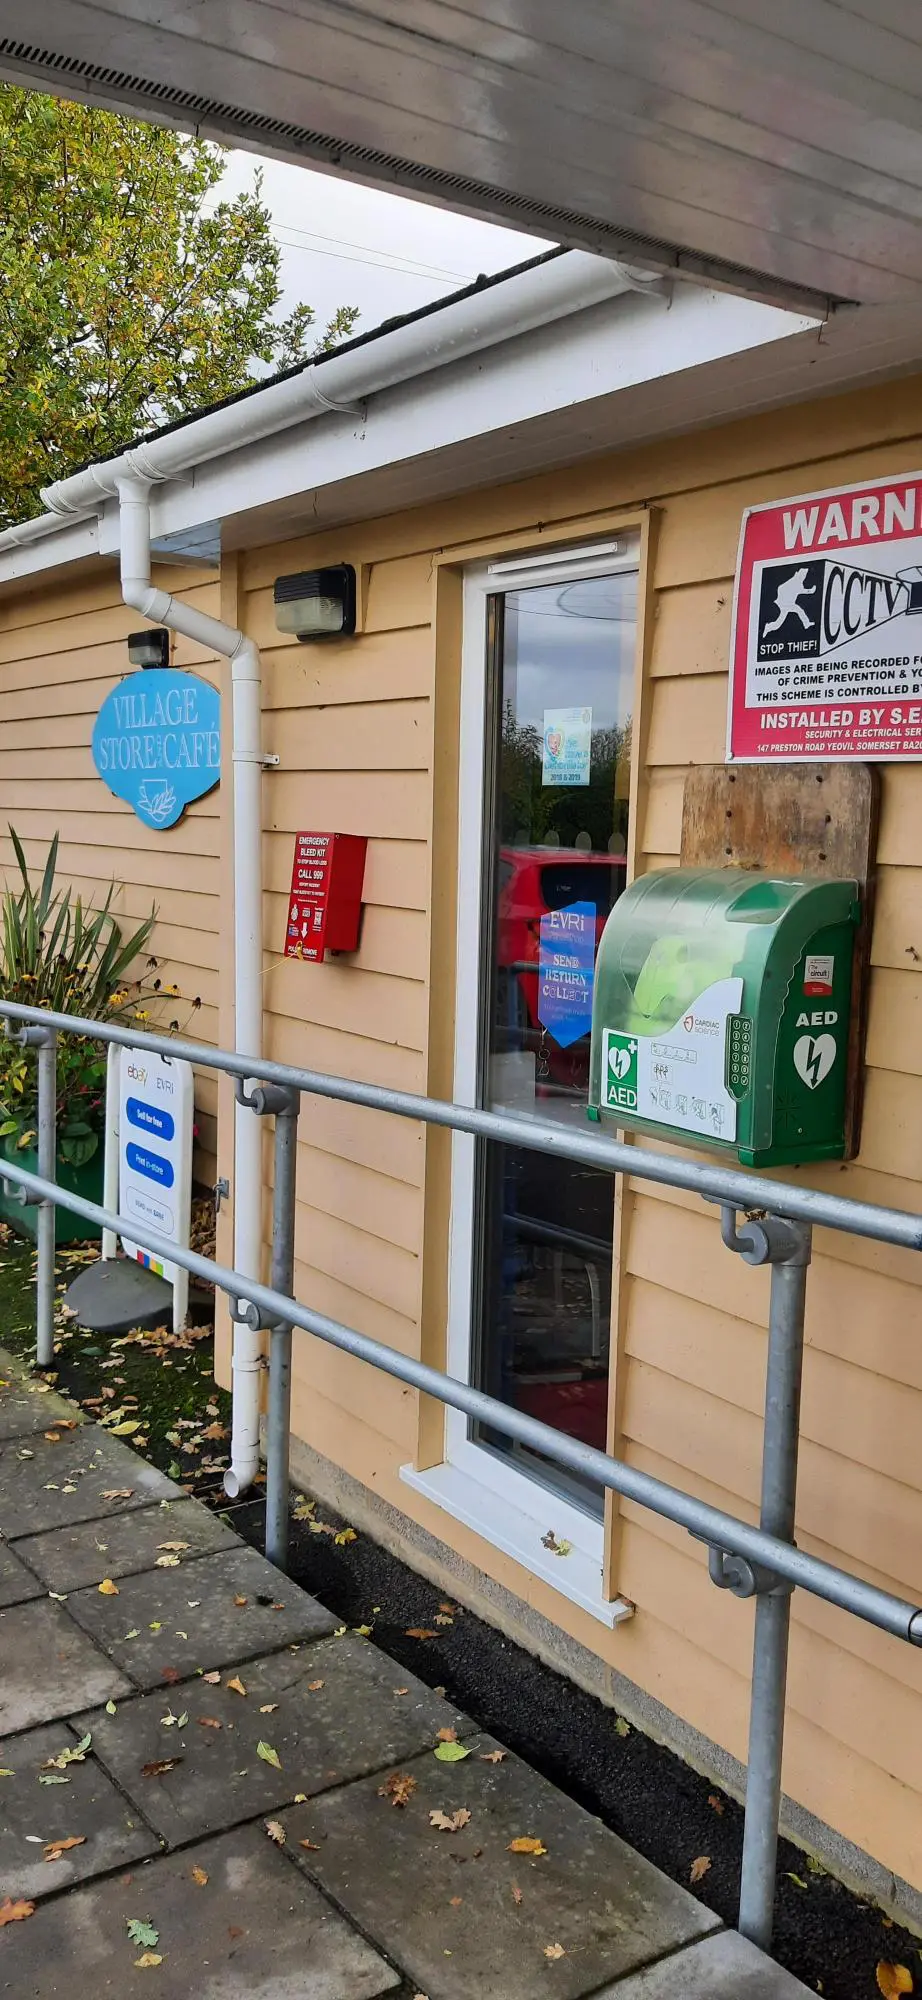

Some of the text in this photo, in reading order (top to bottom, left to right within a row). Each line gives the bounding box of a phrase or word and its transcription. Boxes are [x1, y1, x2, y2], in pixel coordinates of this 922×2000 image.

[783, 487, 922, 550] WARN
[824, 566, 902, 645] CCTV
[760, 641, 817, 655] STOP THIEF!
[755, 656, 922, 676] IMAGES ARE BEING RECORDED F
[778, 677, 790, 687] OF
[793, 675, 824, 686] CRIME
[827, 670, 895, 684] PREVENTION
[899, 670, 906, 679] &
[756, 684, 922, 702] THIS SCHEME IS CONTROLLED B
[112, 688, 199, 729] VILLAGE
[760, 710, 854, 729] INSTALLED
[859, 708, 885, 726] BY
[805, 730, 843, 739] SECURITY
[844, 729, 851, 738] &
[853, 728, 902, 738] ELECTRICAL
[100, 735, 157, 770] STORE
[163, 721, 220, 768] CAFÉ
[757, 744, 769, 752] 147
[770, 743, 803, 752] PRESTON
[805, 743, 825, 752] ROAD
[828, 742, 855, 752] YEOVIL
[857, 741, 902, 750] SOMERSET
[299, 836, 330, 846] EMERGENCY
[301, 848, 326, 857] BLEED KIT
[298, 869, 324, 880] CALL 999
[550, 911, 585, 931] EVRi
[553, 954, 580, 969] SEND
[545, 968, 586, 987] RETURN
[810, 969, 827, 977] circuit
[542, 984, 589, 1004] COLLECT
[695, 1019, 720, 1029] CARDIAC
[796, 1011, 838, 1027] AED
[695, 1026, 720, 1036] science
[128, 1064, 148, 1088] ebay
[608, 1086, 636, 1106] AED
[136, 1108, 146, 1120] Sell
[153, 1116, 163, 1128] free
